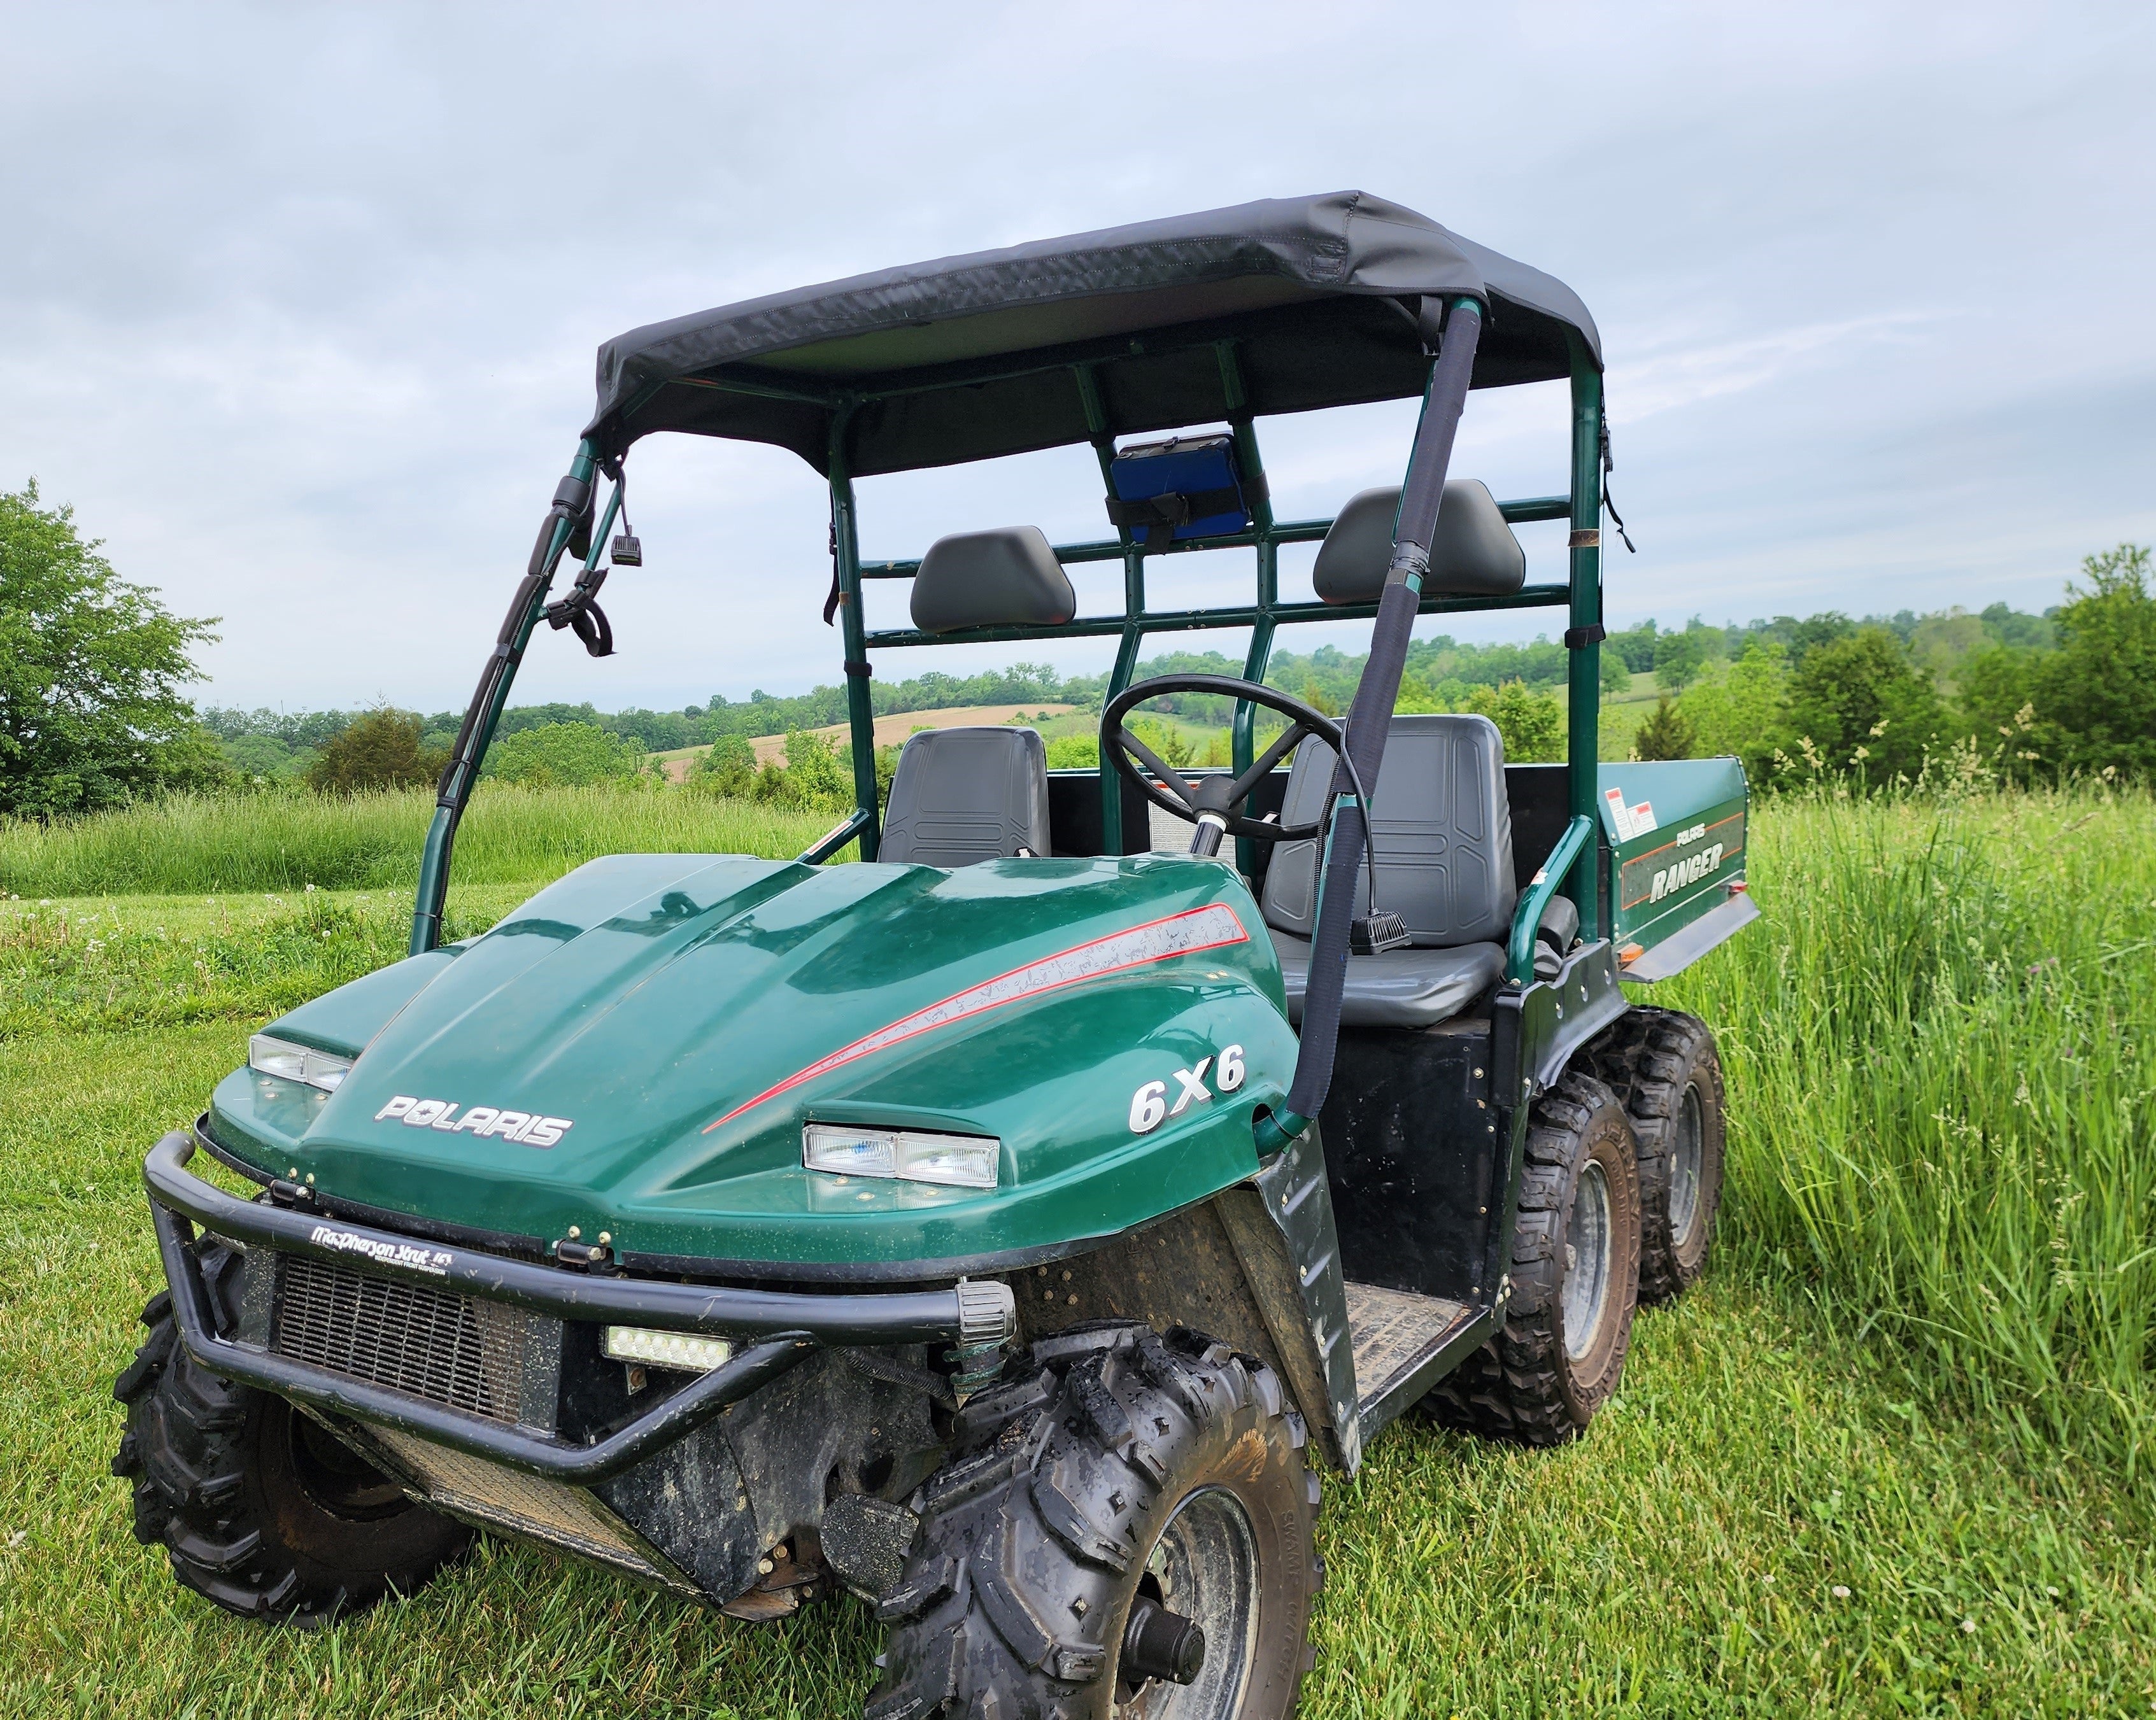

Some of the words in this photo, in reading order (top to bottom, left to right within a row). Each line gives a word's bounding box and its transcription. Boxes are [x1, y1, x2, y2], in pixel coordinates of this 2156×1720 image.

[1677, 822, 1706, 847] POLARIS
[1649, 842, 1723, 904] RANGER
[1129, 1044, 1246, 1134] 6X6
[373, 1095, 574, 1147] POLARIS
[311, 1225, 395, 1258] MacPherson
[394, 1244, 430, 1265] Strut
